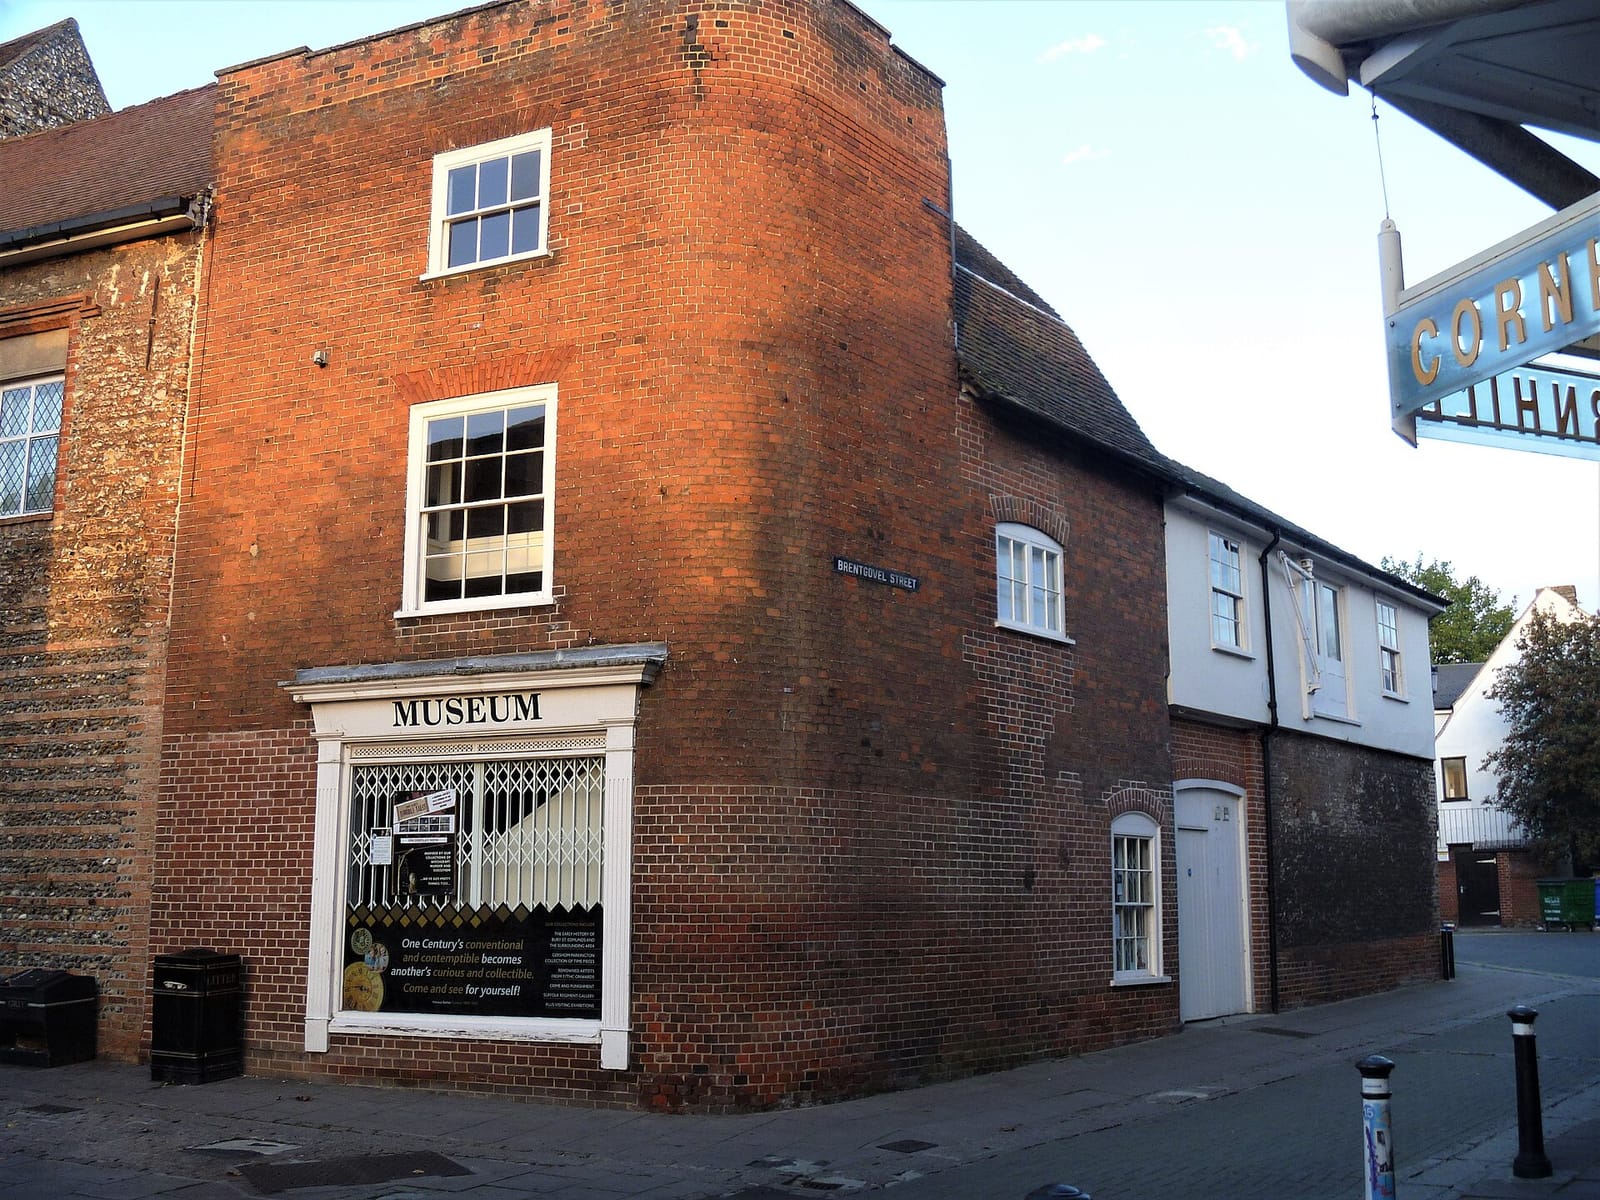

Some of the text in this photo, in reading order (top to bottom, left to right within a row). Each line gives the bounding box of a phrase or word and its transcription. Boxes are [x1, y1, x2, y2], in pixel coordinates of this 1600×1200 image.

[837, 559, 917, 589] BRENTGOVEL STREET
[391, 693, 543, 727] MUSEUM
[401, 938, 524, 952] One Century's conventional
[402, 952, 523, 966] and contemptible becomes
[390, 966, 535, 980] another's curious and collectible.
[403, 983, 521, 998] Come and see for yourself!
[1364, 1107, 1374, 1119] 15
